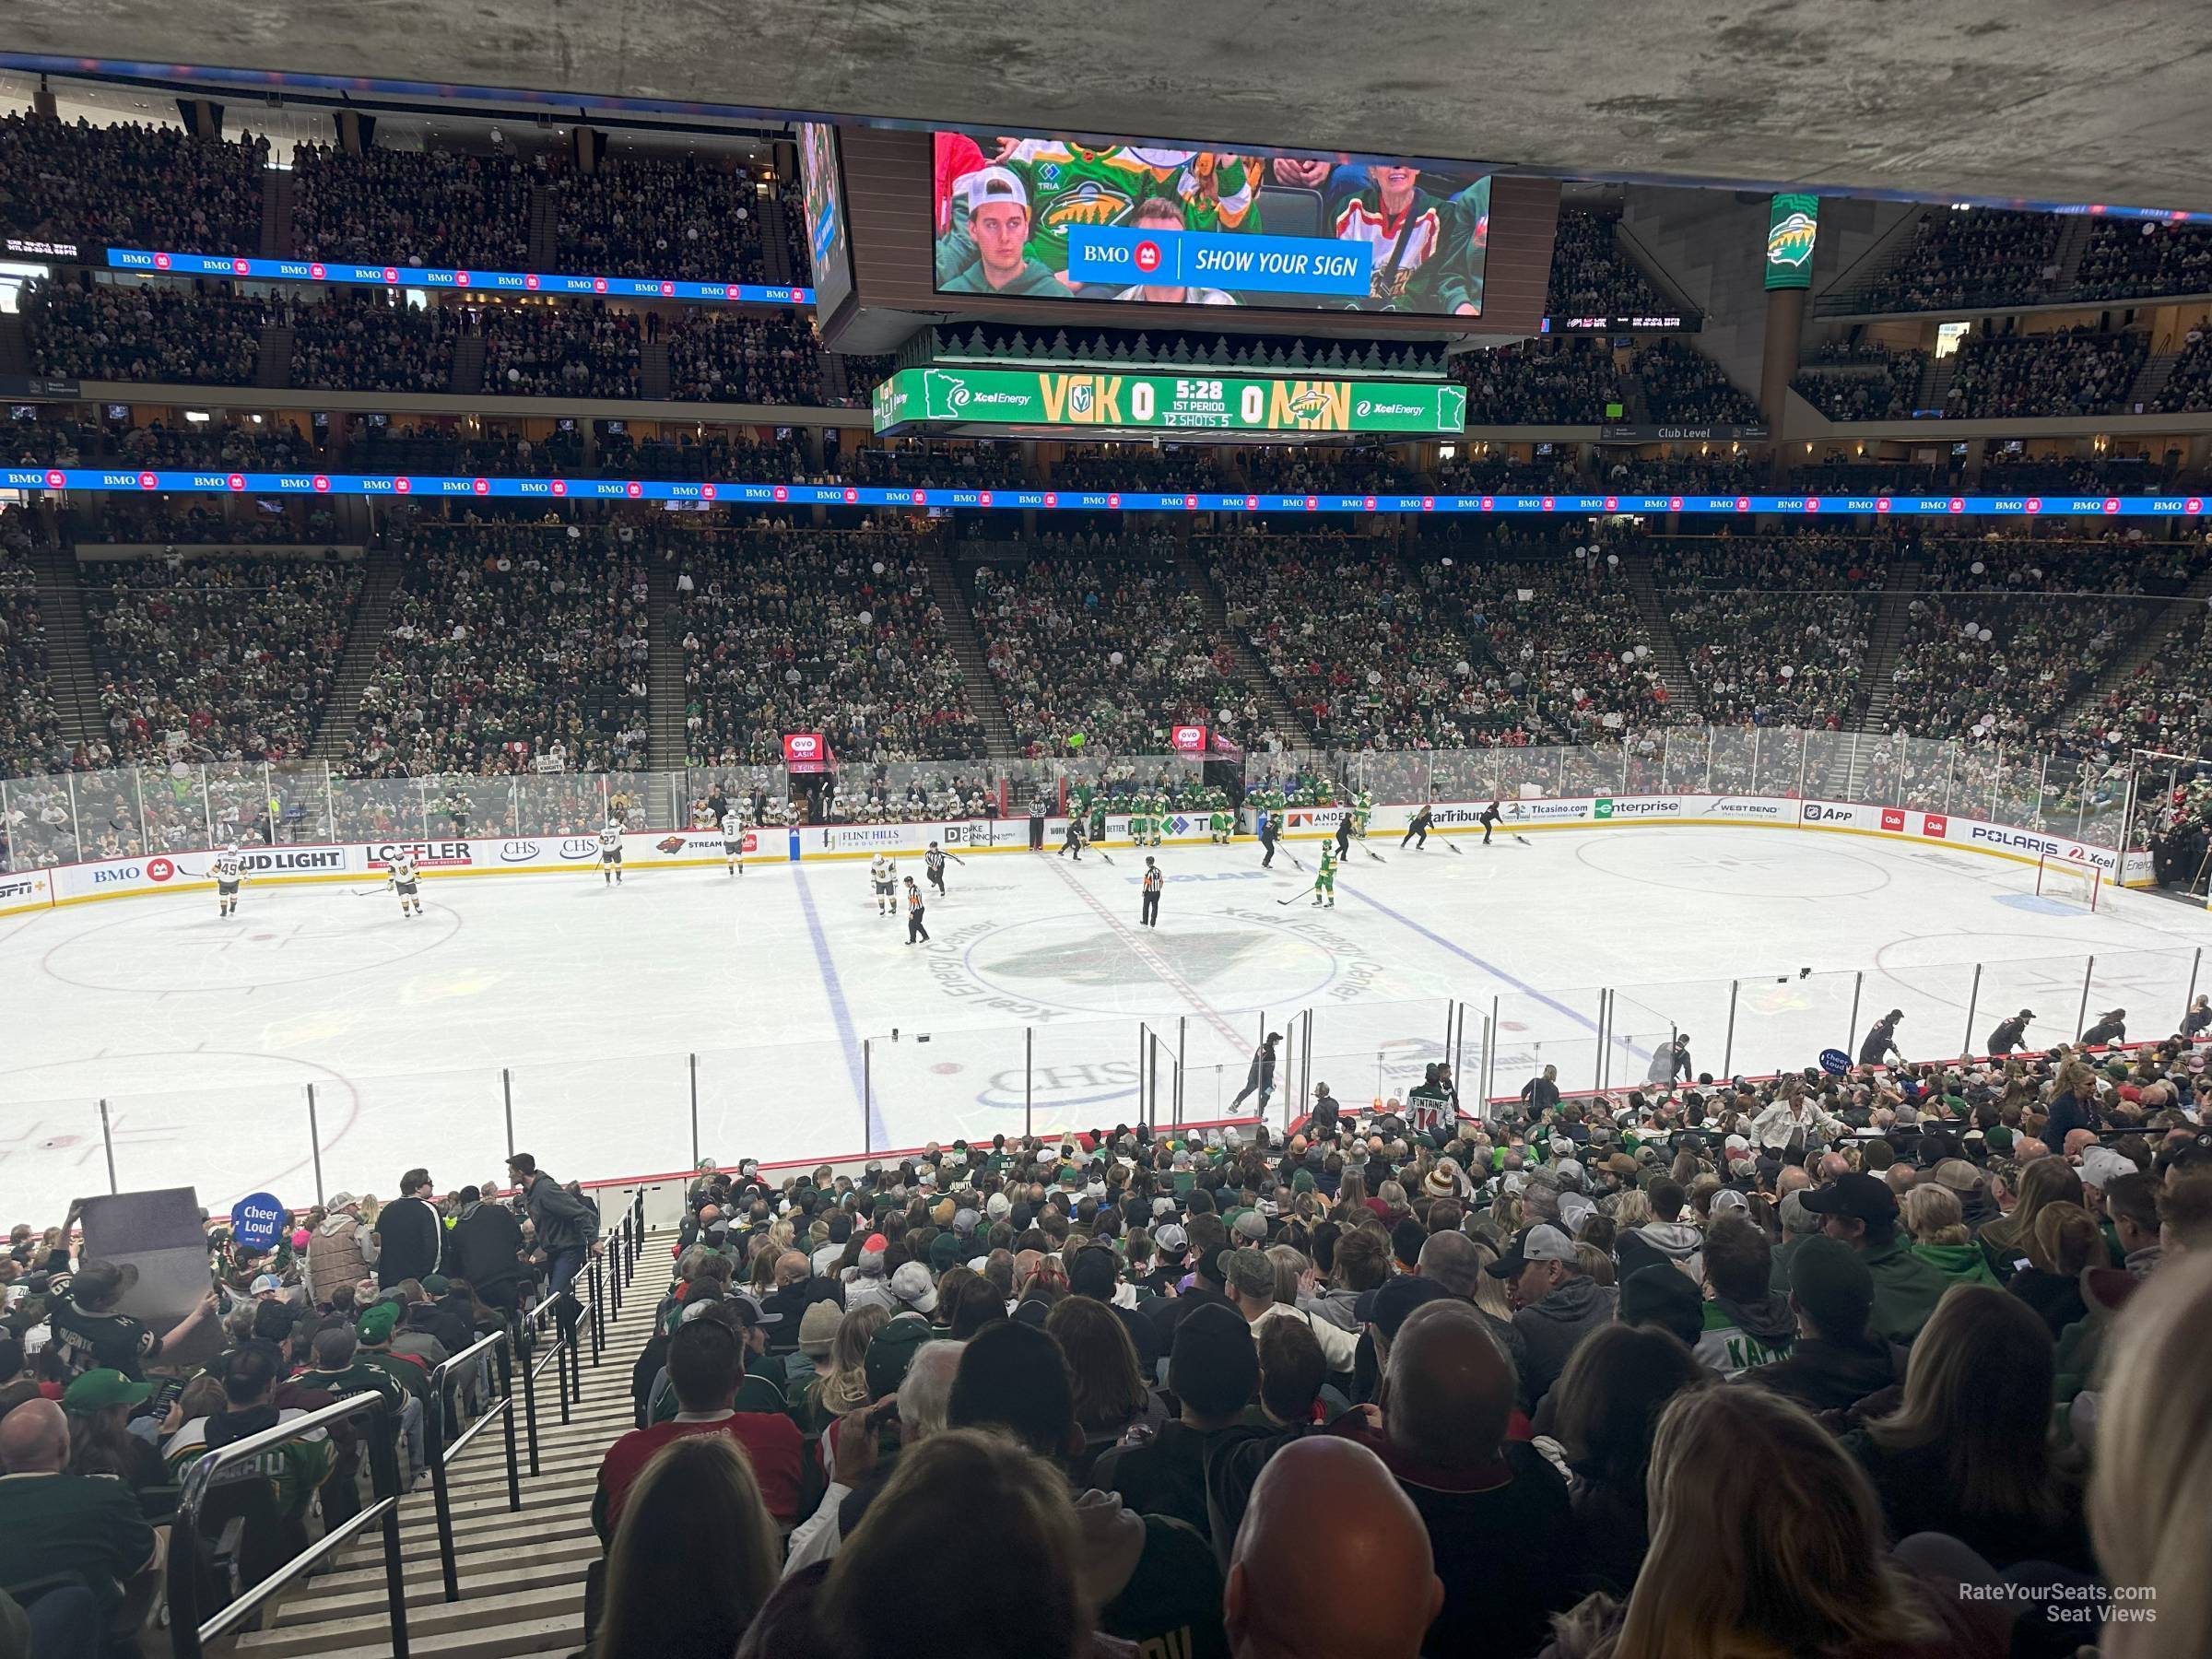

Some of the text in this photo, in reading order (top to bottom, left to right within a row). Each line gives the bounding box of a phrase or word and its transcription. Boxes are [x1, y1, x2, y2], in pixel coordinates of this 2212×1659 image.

[123, 255, 151, 264] BMO
[1084, 246, 1129, 264] BMO
[203, 261, 231, 270] BMO
[1195, 250, 1358, 276] SHOW YOUR SIGN
[280, 266, 308, 275] BMO
[428, 274, 453, 282] BMO
[498, 277, 523, 286] BMO
[635, 284, 659, 292] BMO
[1176, 381, 1222, 400] 5:28
[1040, 373, 1122, 423] VGK
[1132, 382, 1154, 420] 0
[1241, 385, 1264, 423] 0
[1172, 401, 1225, 412] 1ST PERIOD
[1268, 381, 1351, 430] MIN
[1164, 415, 1230, 427] 12 SHOTS 5
[1659, 429, 1711, 438] Club Level
[8, 475, 42, 484] BMO
[103, 477, 135, 485] BMO
[194, 478, 225, 487] BMO
[280, 479, 310, 488] BMO
[363, 481, 392, 489] BMO
[521, 484, 548, 492] BMO
[597, 486, 624, 494] BMO
[746, 489, 771, 498] BMO
[2153, 502, 2183, 511] BMO
[1601, 800, 1679, 814] enterprise
[1886, 817, 1901, 825] Cub
[1928, 822, 1943, 830] Cub
[727, 825, 734, 835] 3
[842, 829, 899, 841] FLINT HILLS
[962, 825, 983, 834] DUKE
[604, 835, 616, 845] 27
[962, 831, 1000, 841] CANNON
[1972, 827, 2058, 855] POLARIS
[504, 841, 536, 853] CHS
[563, 840, 595, 852] CHS
[688, 841, 722, 849] STREAM
[242, 853, 340, 870] UD LIGHT
[2089, 853, 2115, 869] Xcel
[221, 859, 237, 876] 49
[94, 866, 140, 883] BMO
[926, 920, 998, 952] Center
[1290, 923, 1371, 959] Energy
[1329, 962, 1383, 1002] Center
[1826, 1053, 1848, 1065] Cheer
[1826, 1060, 1844, 1071] Loud
[989, 1061, 1140, 1093] CHS
[1412, 1096, 1444, 1110] FONTAINE
[1417, 1108, 1438, 1130] 14
[244, 1206, 277, 1220] Cheer
[245, 1220, 274, 1234] Loud
